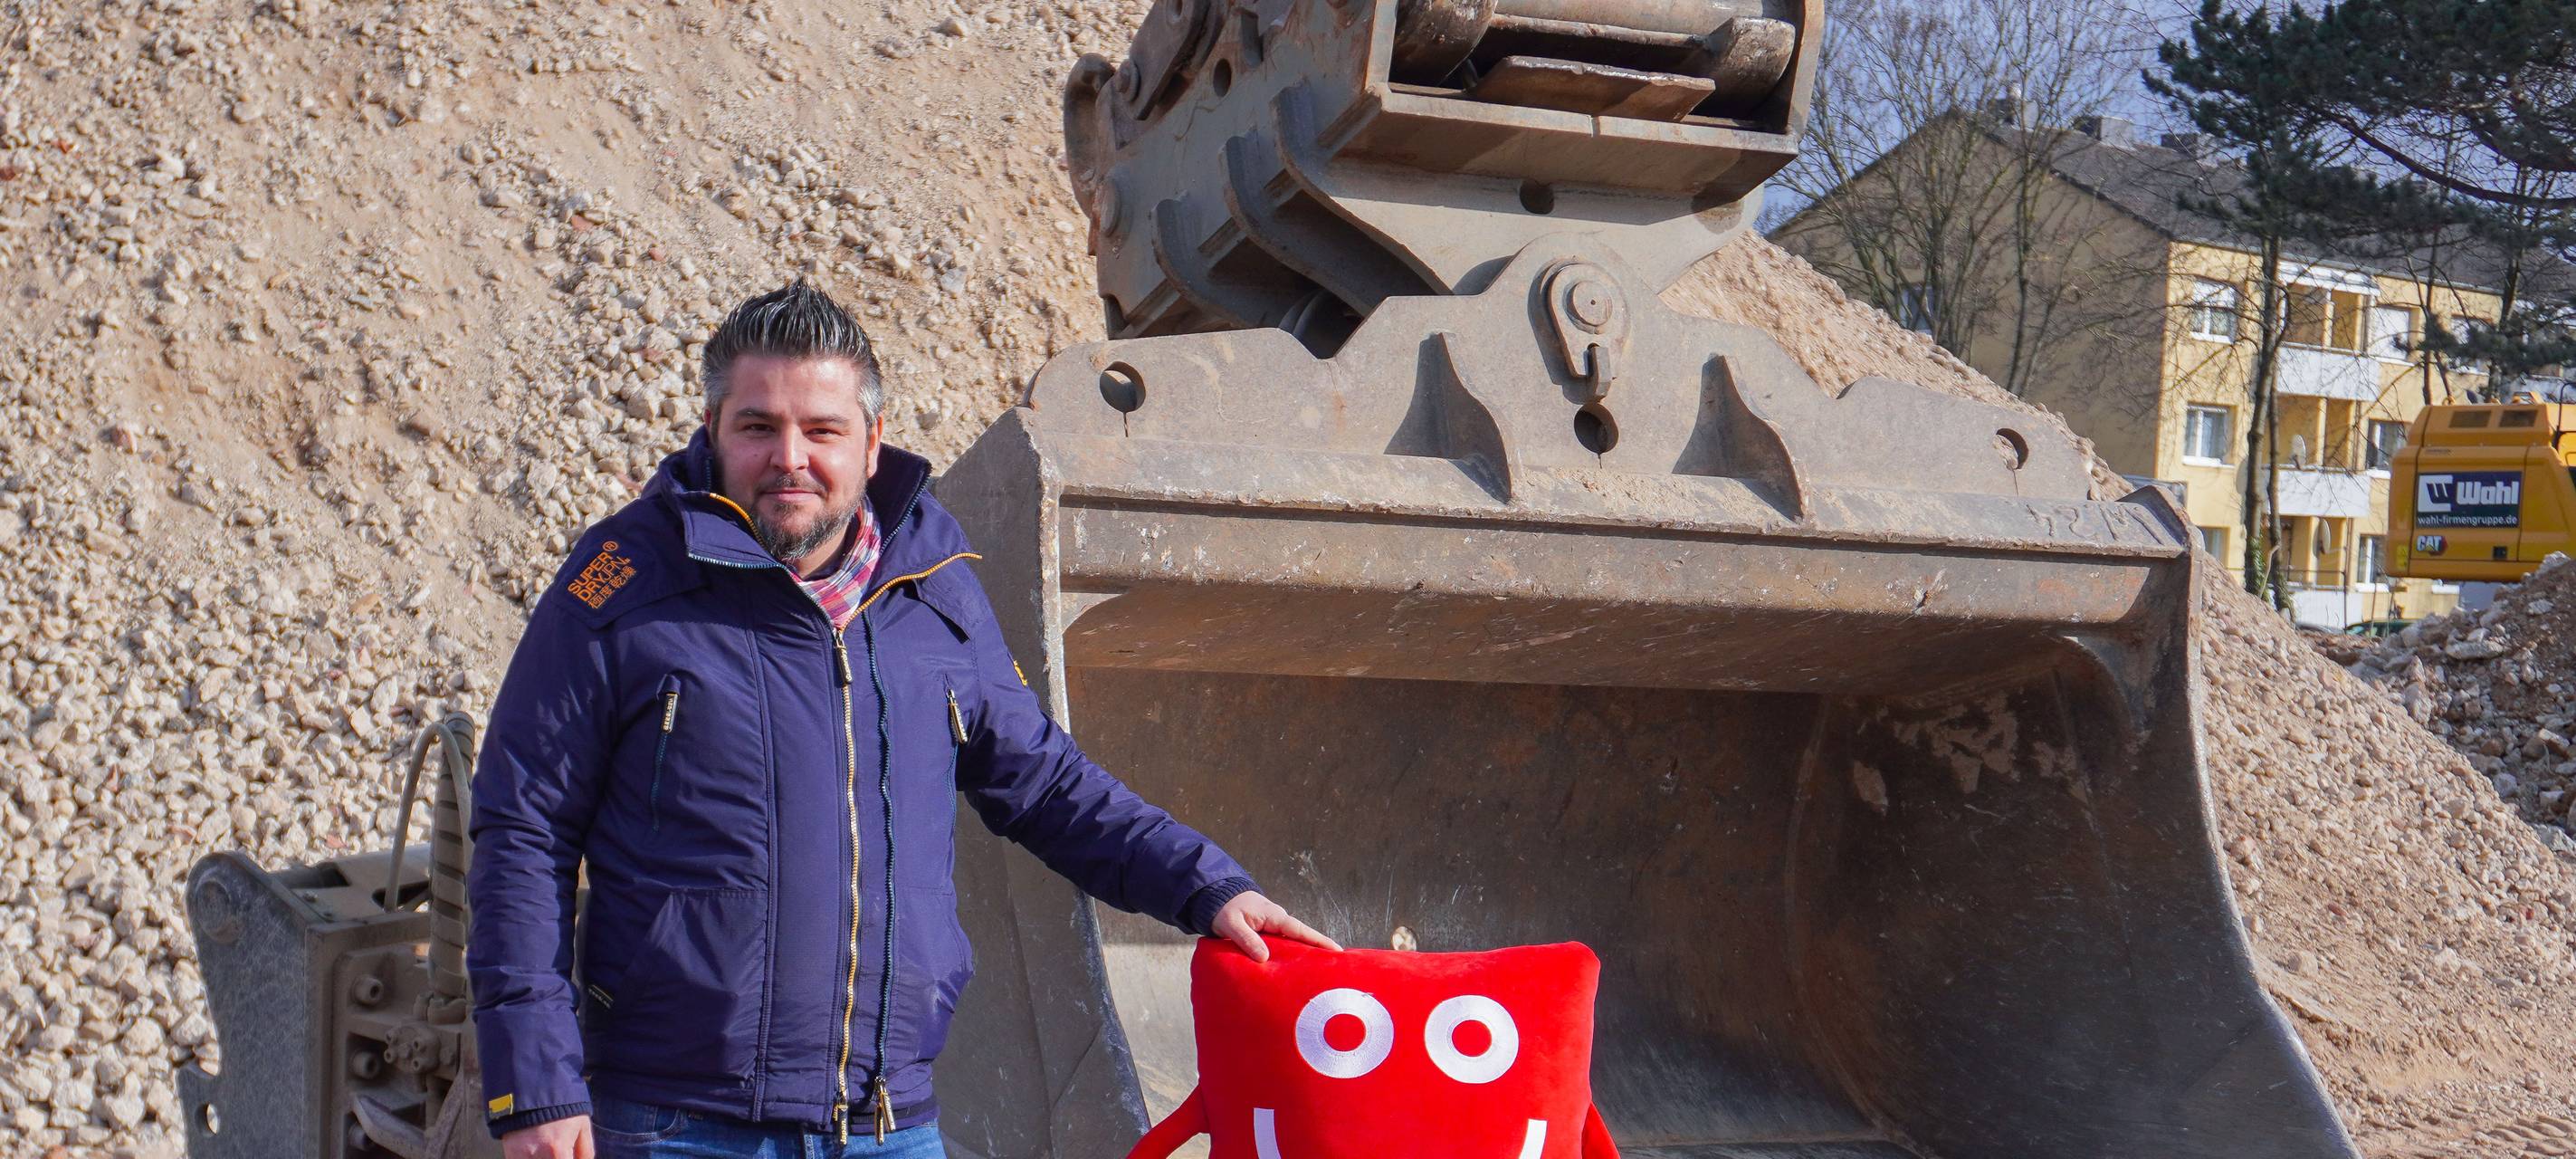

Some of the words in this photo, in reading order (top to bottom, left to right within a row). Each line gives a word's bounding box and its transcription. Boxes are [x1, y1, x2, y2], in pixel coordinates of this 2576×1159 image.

[2457, 481, 2519, 504] Wahl
[2418, 514, 2517, 526] wahl-firmengruppe.de
[2417, 535, 2442, 551] CAT
